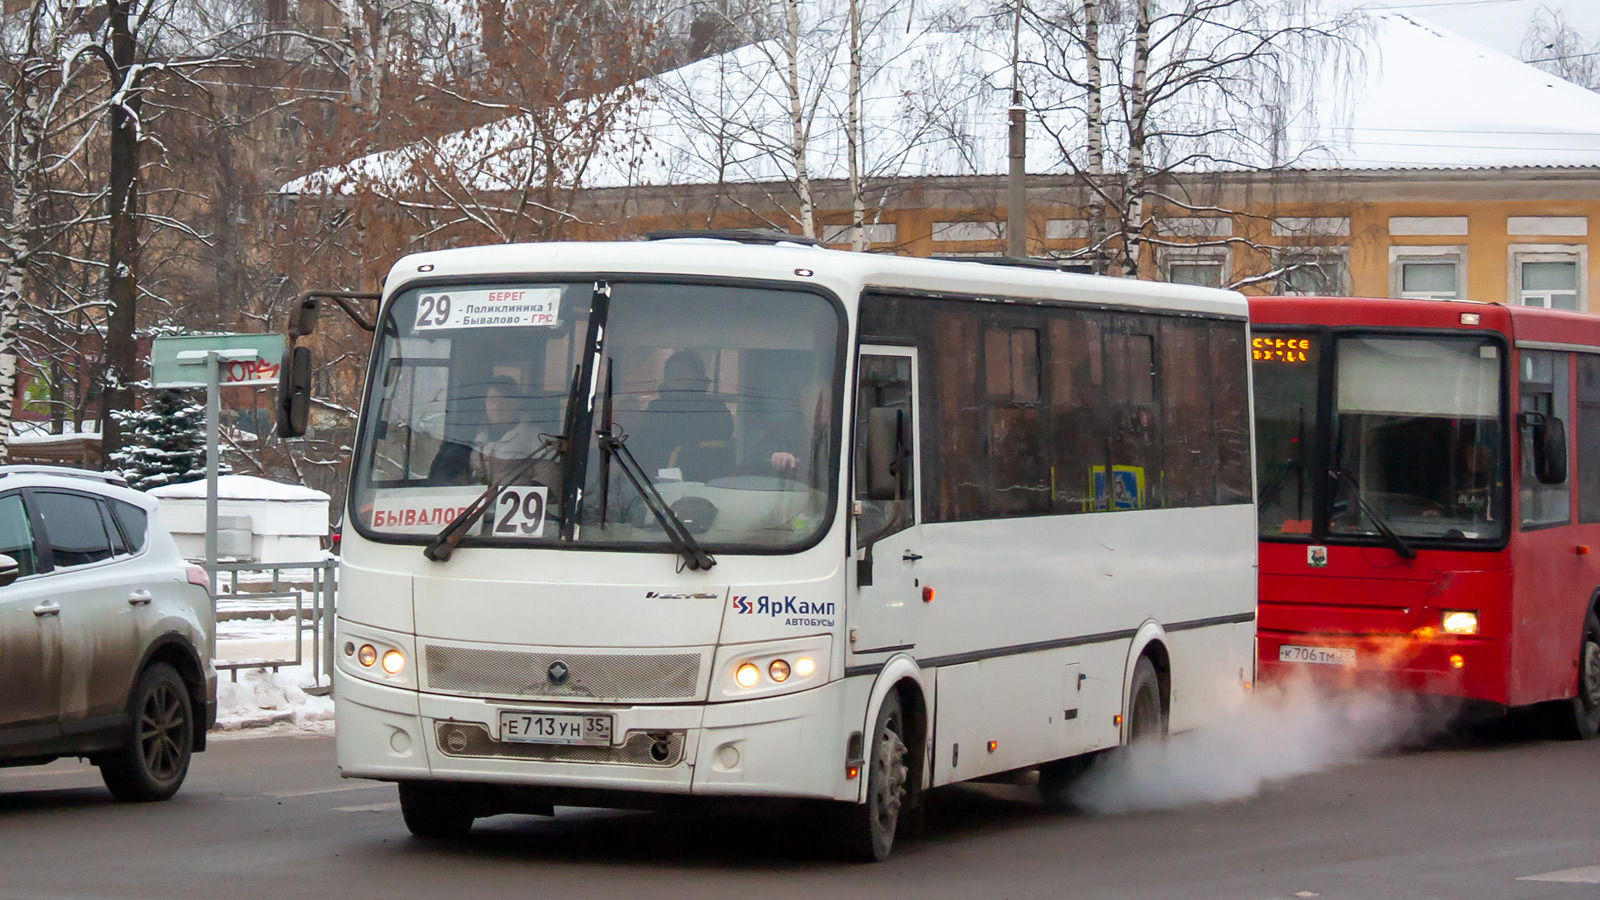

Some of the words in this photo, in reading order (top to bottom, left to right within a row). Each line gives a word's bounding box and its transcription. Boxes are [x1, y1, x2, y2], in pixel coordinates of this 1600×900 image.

[488, 291, 526, 301] БЕРЕГ
[416, 295, 451, 327] 29
[466, 303, 543, 314] Поликлиника
[547, 302, 552, 312] 1
[463, 315, 520, 326] Бывалово
[531, 314, 554, 324] ГРС
[373, 507, 480, 528] БЫВАЛО
[495, 490, 543, 535] 29
[756, 596, 835, 617] ЯрКамп
[785, 618, 835, 627] АВТОБУСЫ
[586, 718, 604, 732] 35
